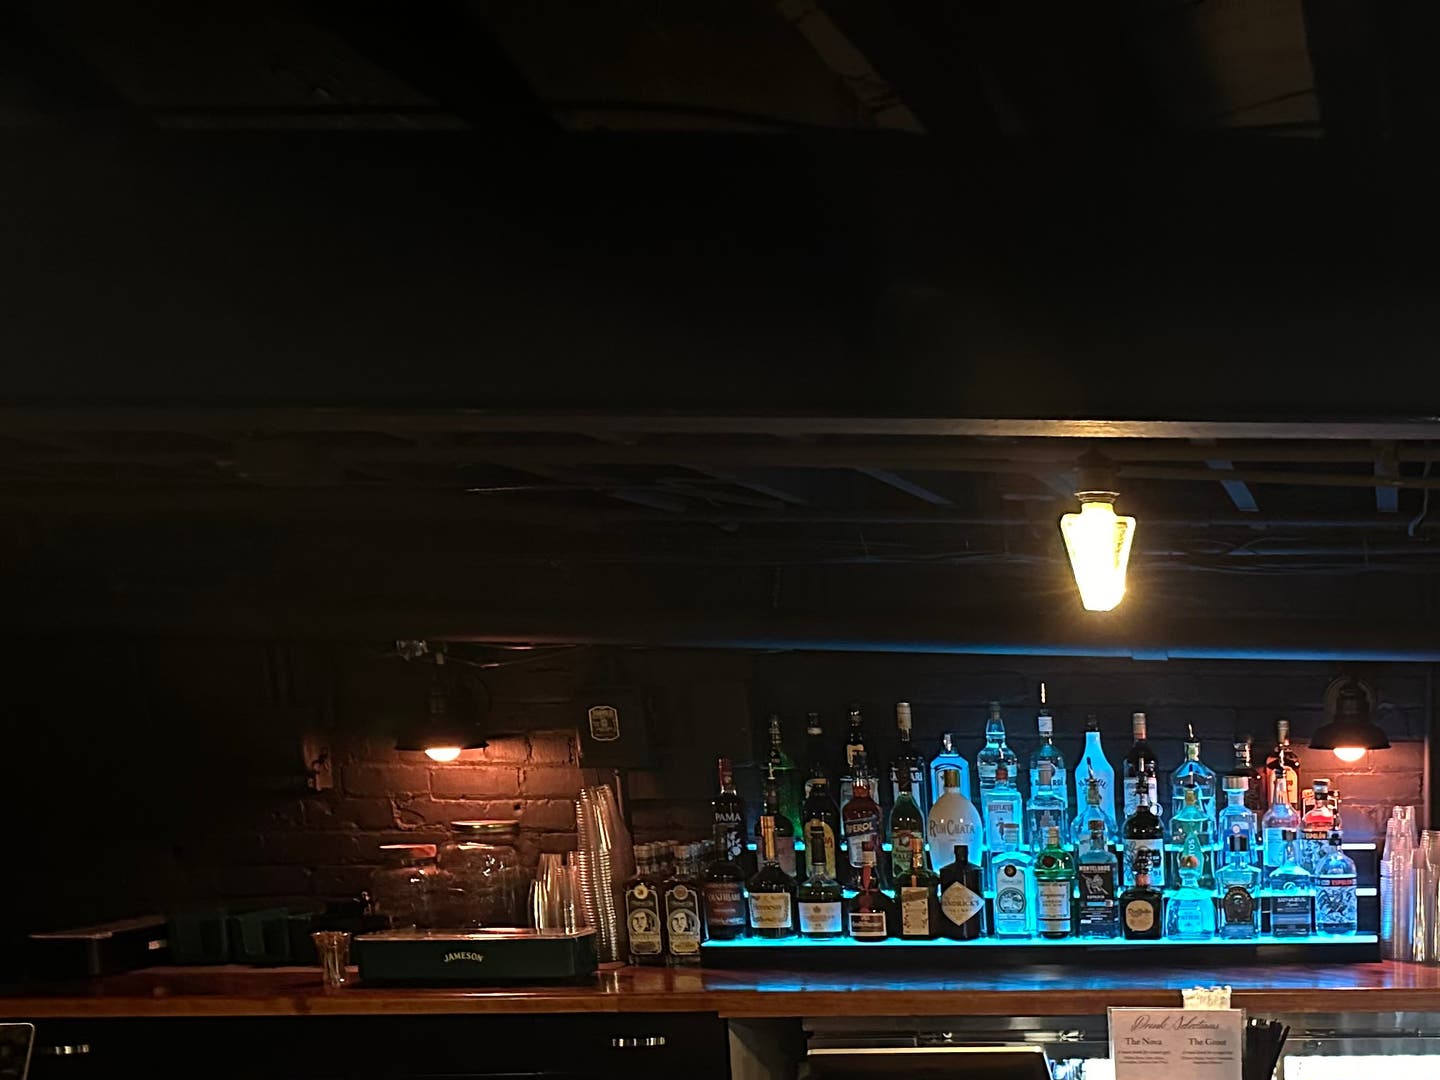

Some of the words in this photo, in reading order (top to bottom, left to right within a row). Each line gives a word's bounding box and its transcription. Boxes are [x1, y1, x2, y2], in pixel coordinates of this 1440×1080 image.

[714, 811, 742, 822] PAMA
[443, 951, 485, 963] JAMESON
[1126, 1037, 1141, 1045] The
[1189, 1037, 1203, 1046] The
